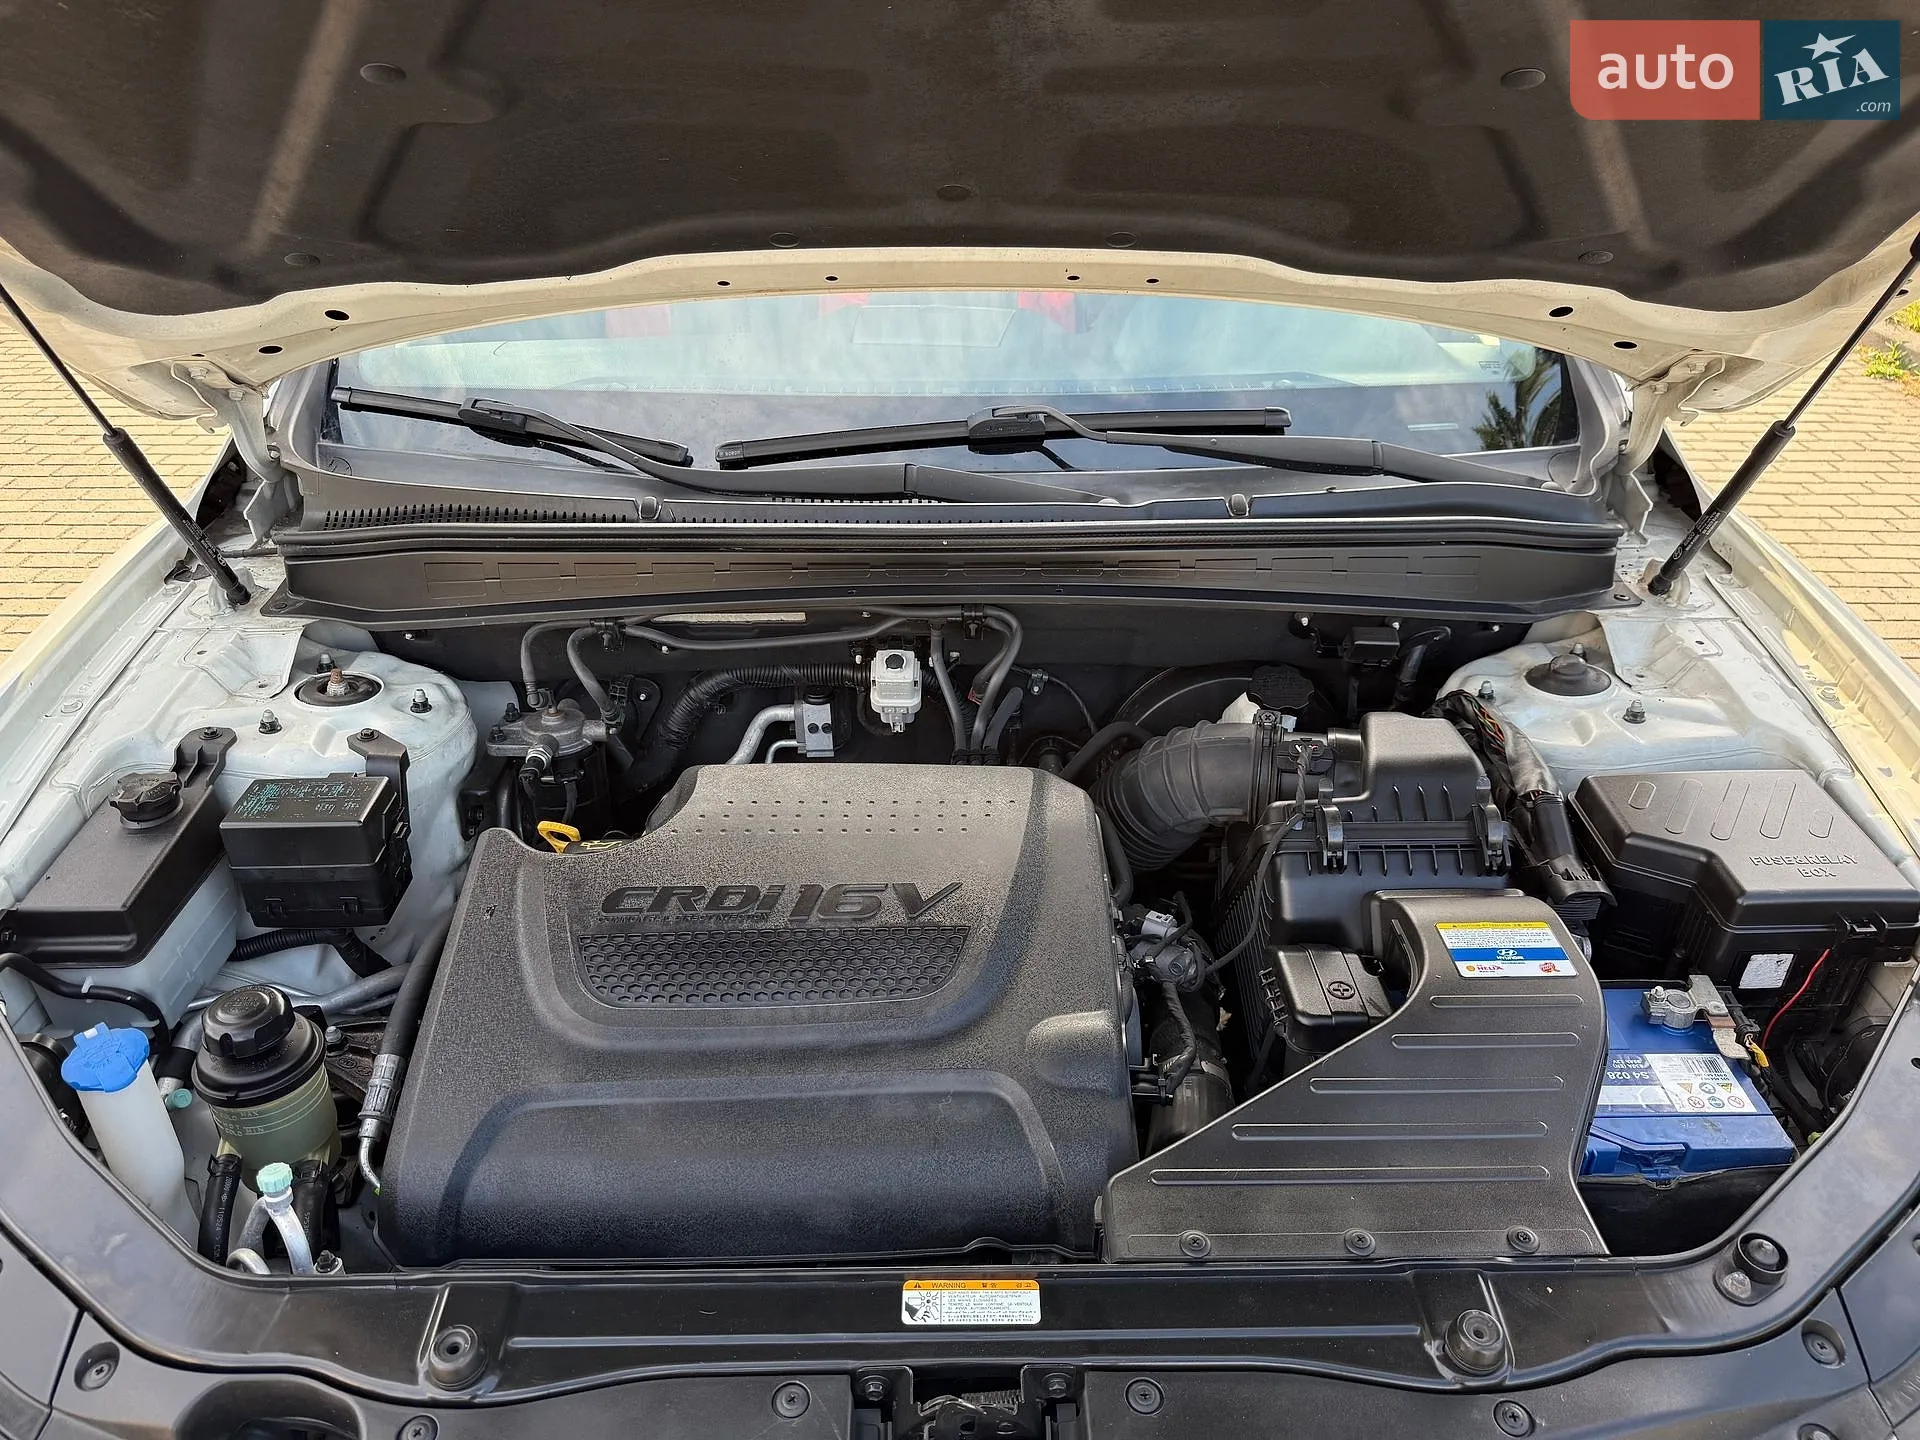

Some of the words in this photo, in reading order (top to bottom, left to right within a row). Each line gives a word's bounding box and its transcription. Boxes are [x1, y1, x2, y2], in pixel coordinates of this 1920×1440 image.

[1797, 867, 1837, 878] BOX
[788, 881, 964, 922] 16V
[1607, 1071, 1631, 1080] 028
